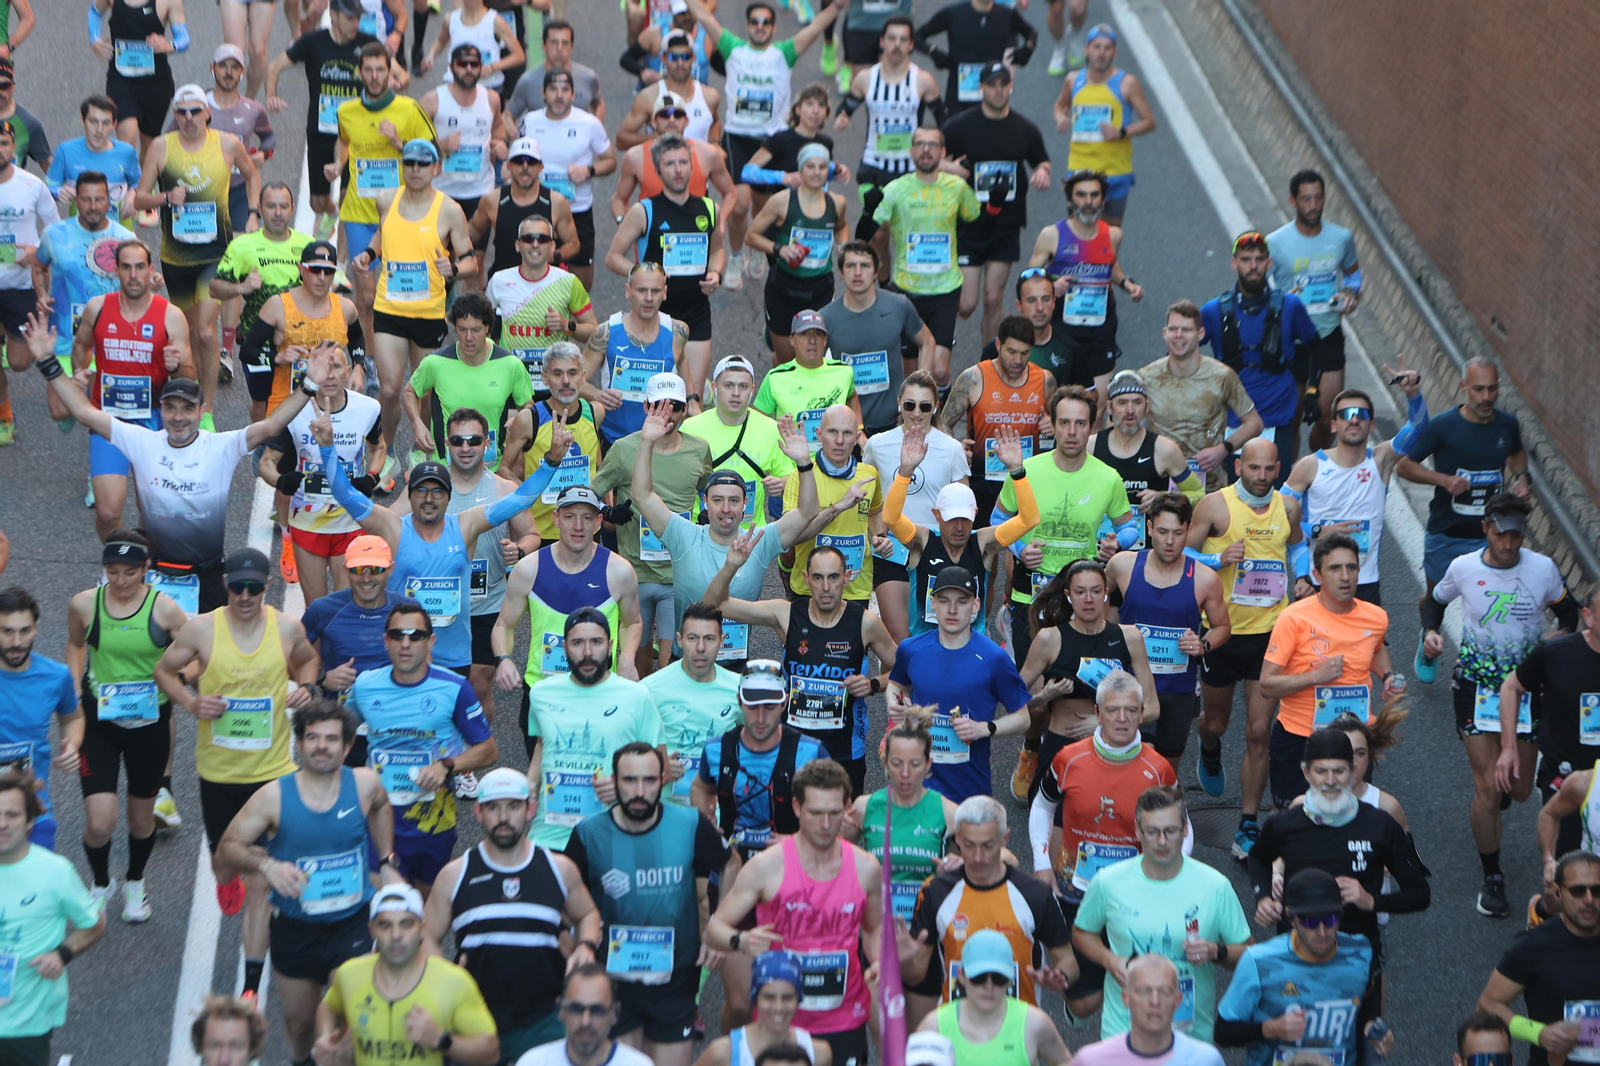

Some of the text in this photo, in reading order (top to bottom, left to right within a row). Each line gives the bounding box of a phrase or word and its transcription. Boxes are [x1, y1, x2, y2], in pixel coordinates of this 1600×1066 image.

[321, 83, 358, 97] SEVILLA
[187, 204, 212, 213] ZURICH
[119, 339, 154, 352] ATLETISMO
[103, 347, 153, 364] TREBUJENA
[857, 355, 881, 365] ZURICH
[632, 363, 658, 371] ZURICH
[116, 378, 145, 387] ZURICH
[657, 380, 676, 390] ciele
[116, 392, 136, 401] 11325
[559, 459, 584, 468] ZURICH
[1124, 479, 1148, 488] erna
[834, 538, 860, 546] ZURICH
[1255, 562, 1282, 571] ZURICH
[424, 581, 454, 589] ZURICH
[1253, 577, 1269, 586] 7972
[1249, 588, 1271, 596] SHARON
[1153, 630, 1183, 640] ZURICH
[1152, 645, 1169, 654] 5211
[808, 683, 839, 693] ZURICH
[1335, 688, 1363, 697] ZURICH
[805, 699, 823, 709] 2791
[795, 708, 834, 718] ALBERT ROIG
[563, 775, 592, 786] ZURIC
[1352, 860, 1367, 872] LIV
[635, 866, 683, 888] DOITU
[631, 931, 666, 942] ZURICH
[806, 955, 841, 967] ZURICH
